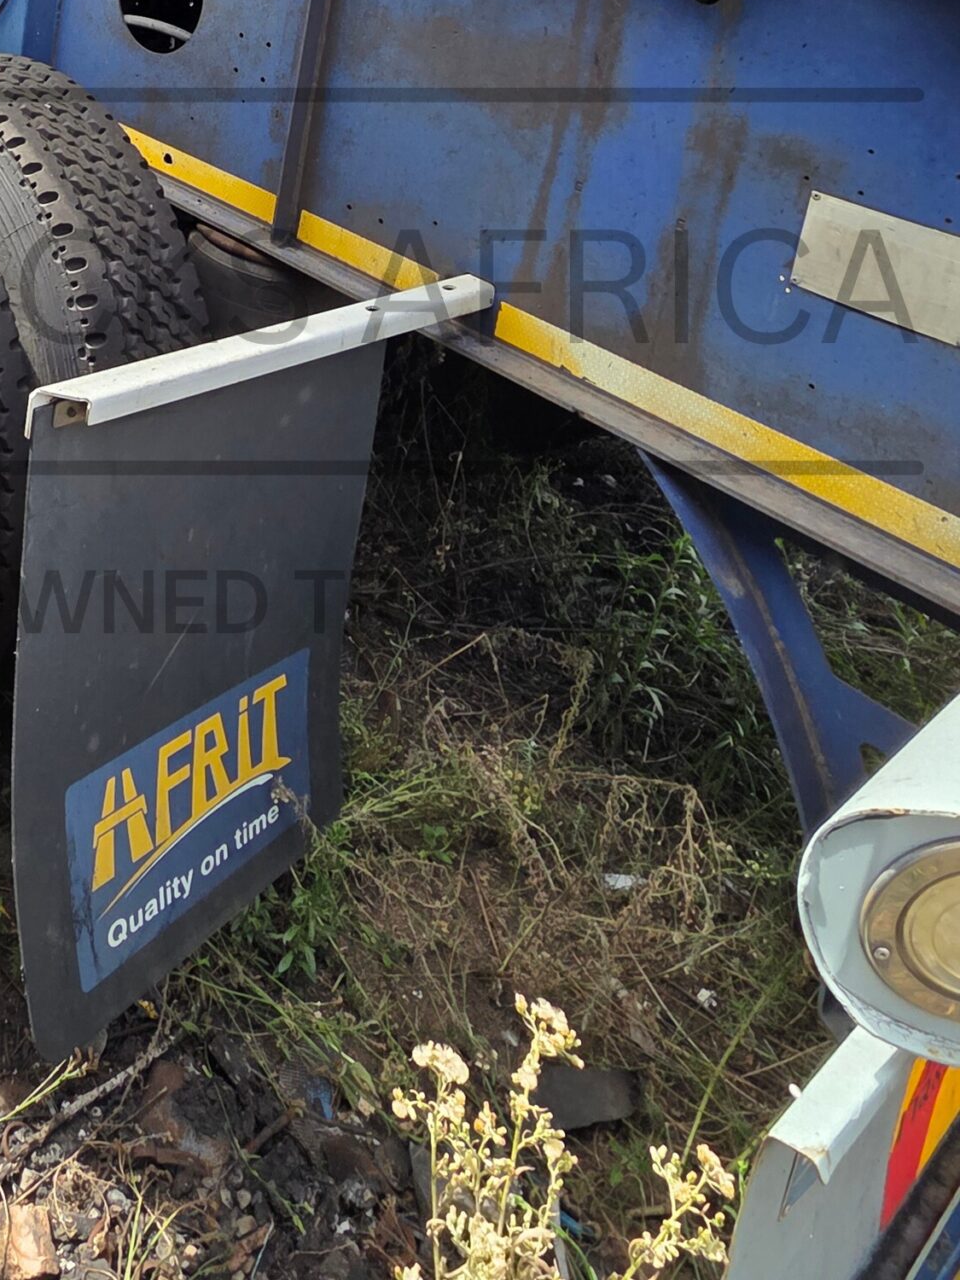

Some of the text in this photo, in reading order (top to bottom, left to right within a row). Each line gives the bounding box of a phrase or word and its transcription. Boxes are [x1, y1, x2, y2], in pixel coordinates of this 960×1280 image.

[107, 804, 279, 948] Quality on time
